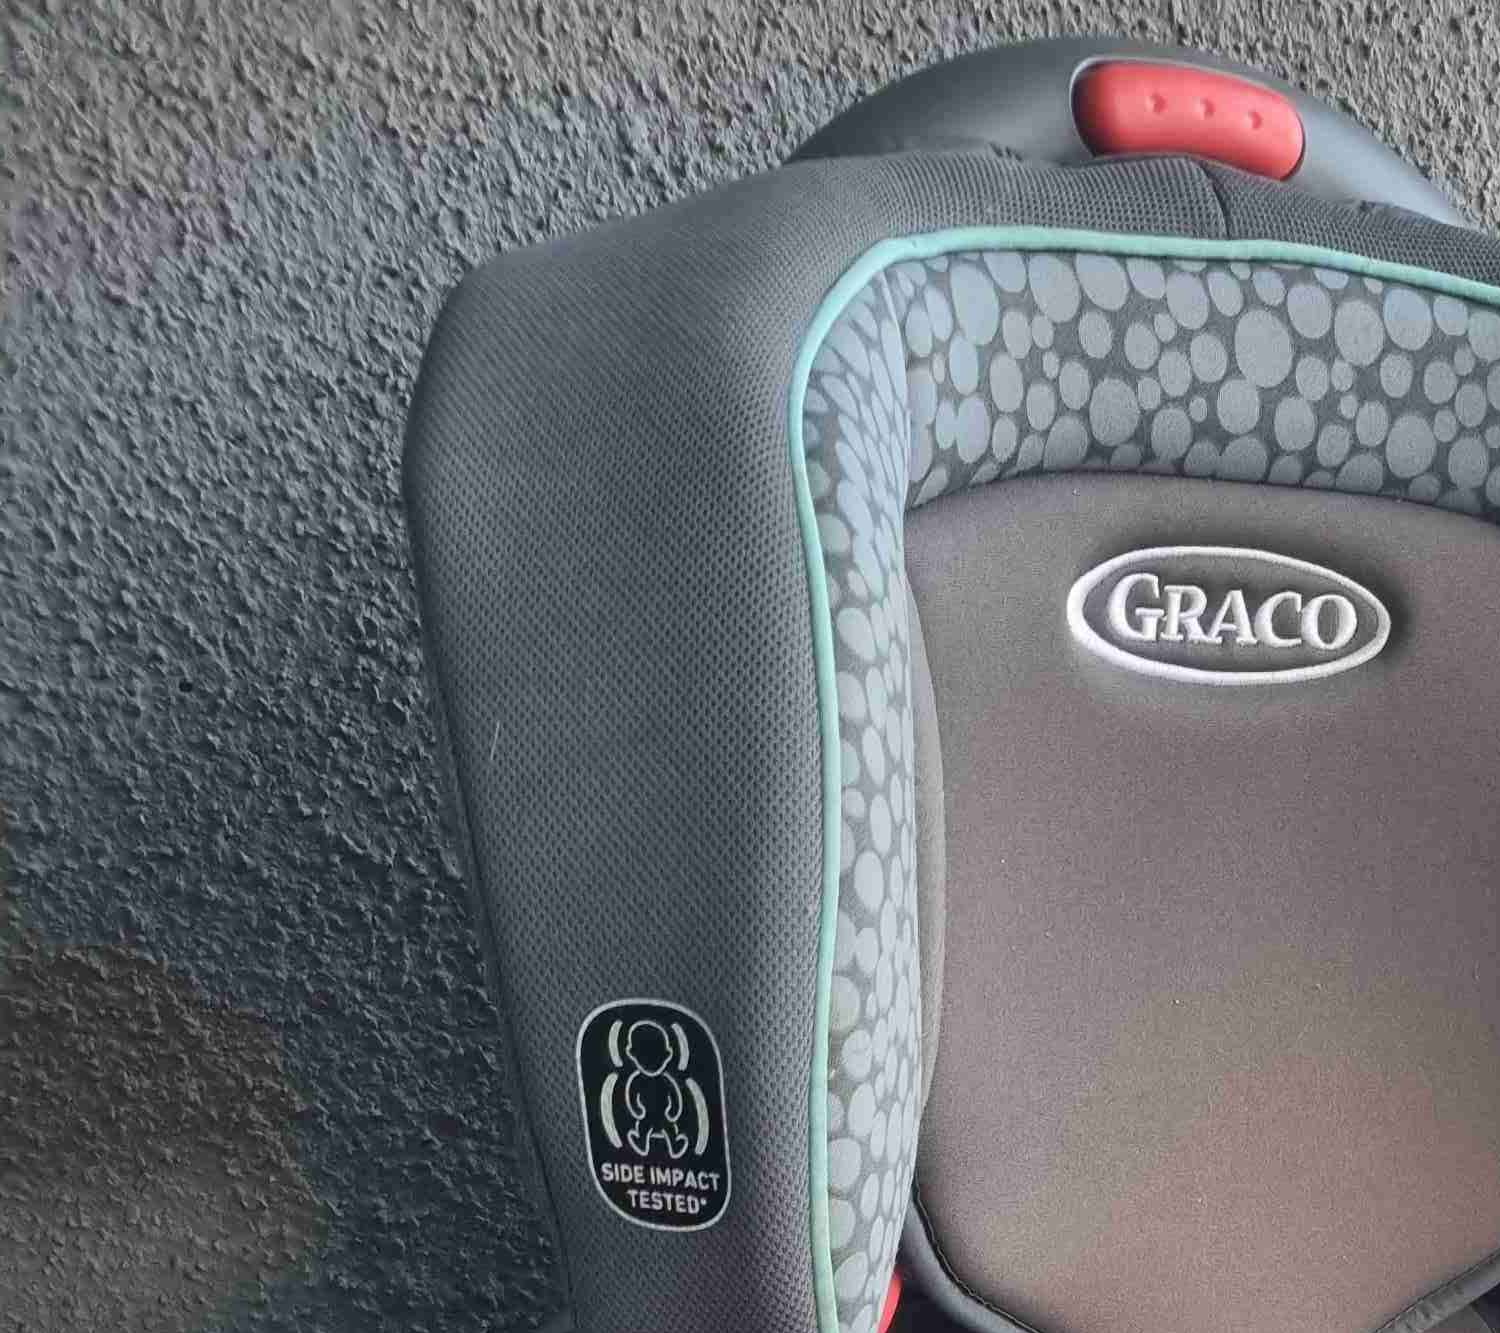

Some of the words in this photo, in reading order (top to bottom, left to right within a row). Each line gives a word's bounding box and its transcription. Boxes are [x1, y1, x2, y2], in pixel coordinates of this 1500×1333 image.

[1107, 573, 1358, 650] GRACO
[601, 1163, 646, 1184] SIDE
[650, 1166, 720, 1191] IMPACT
